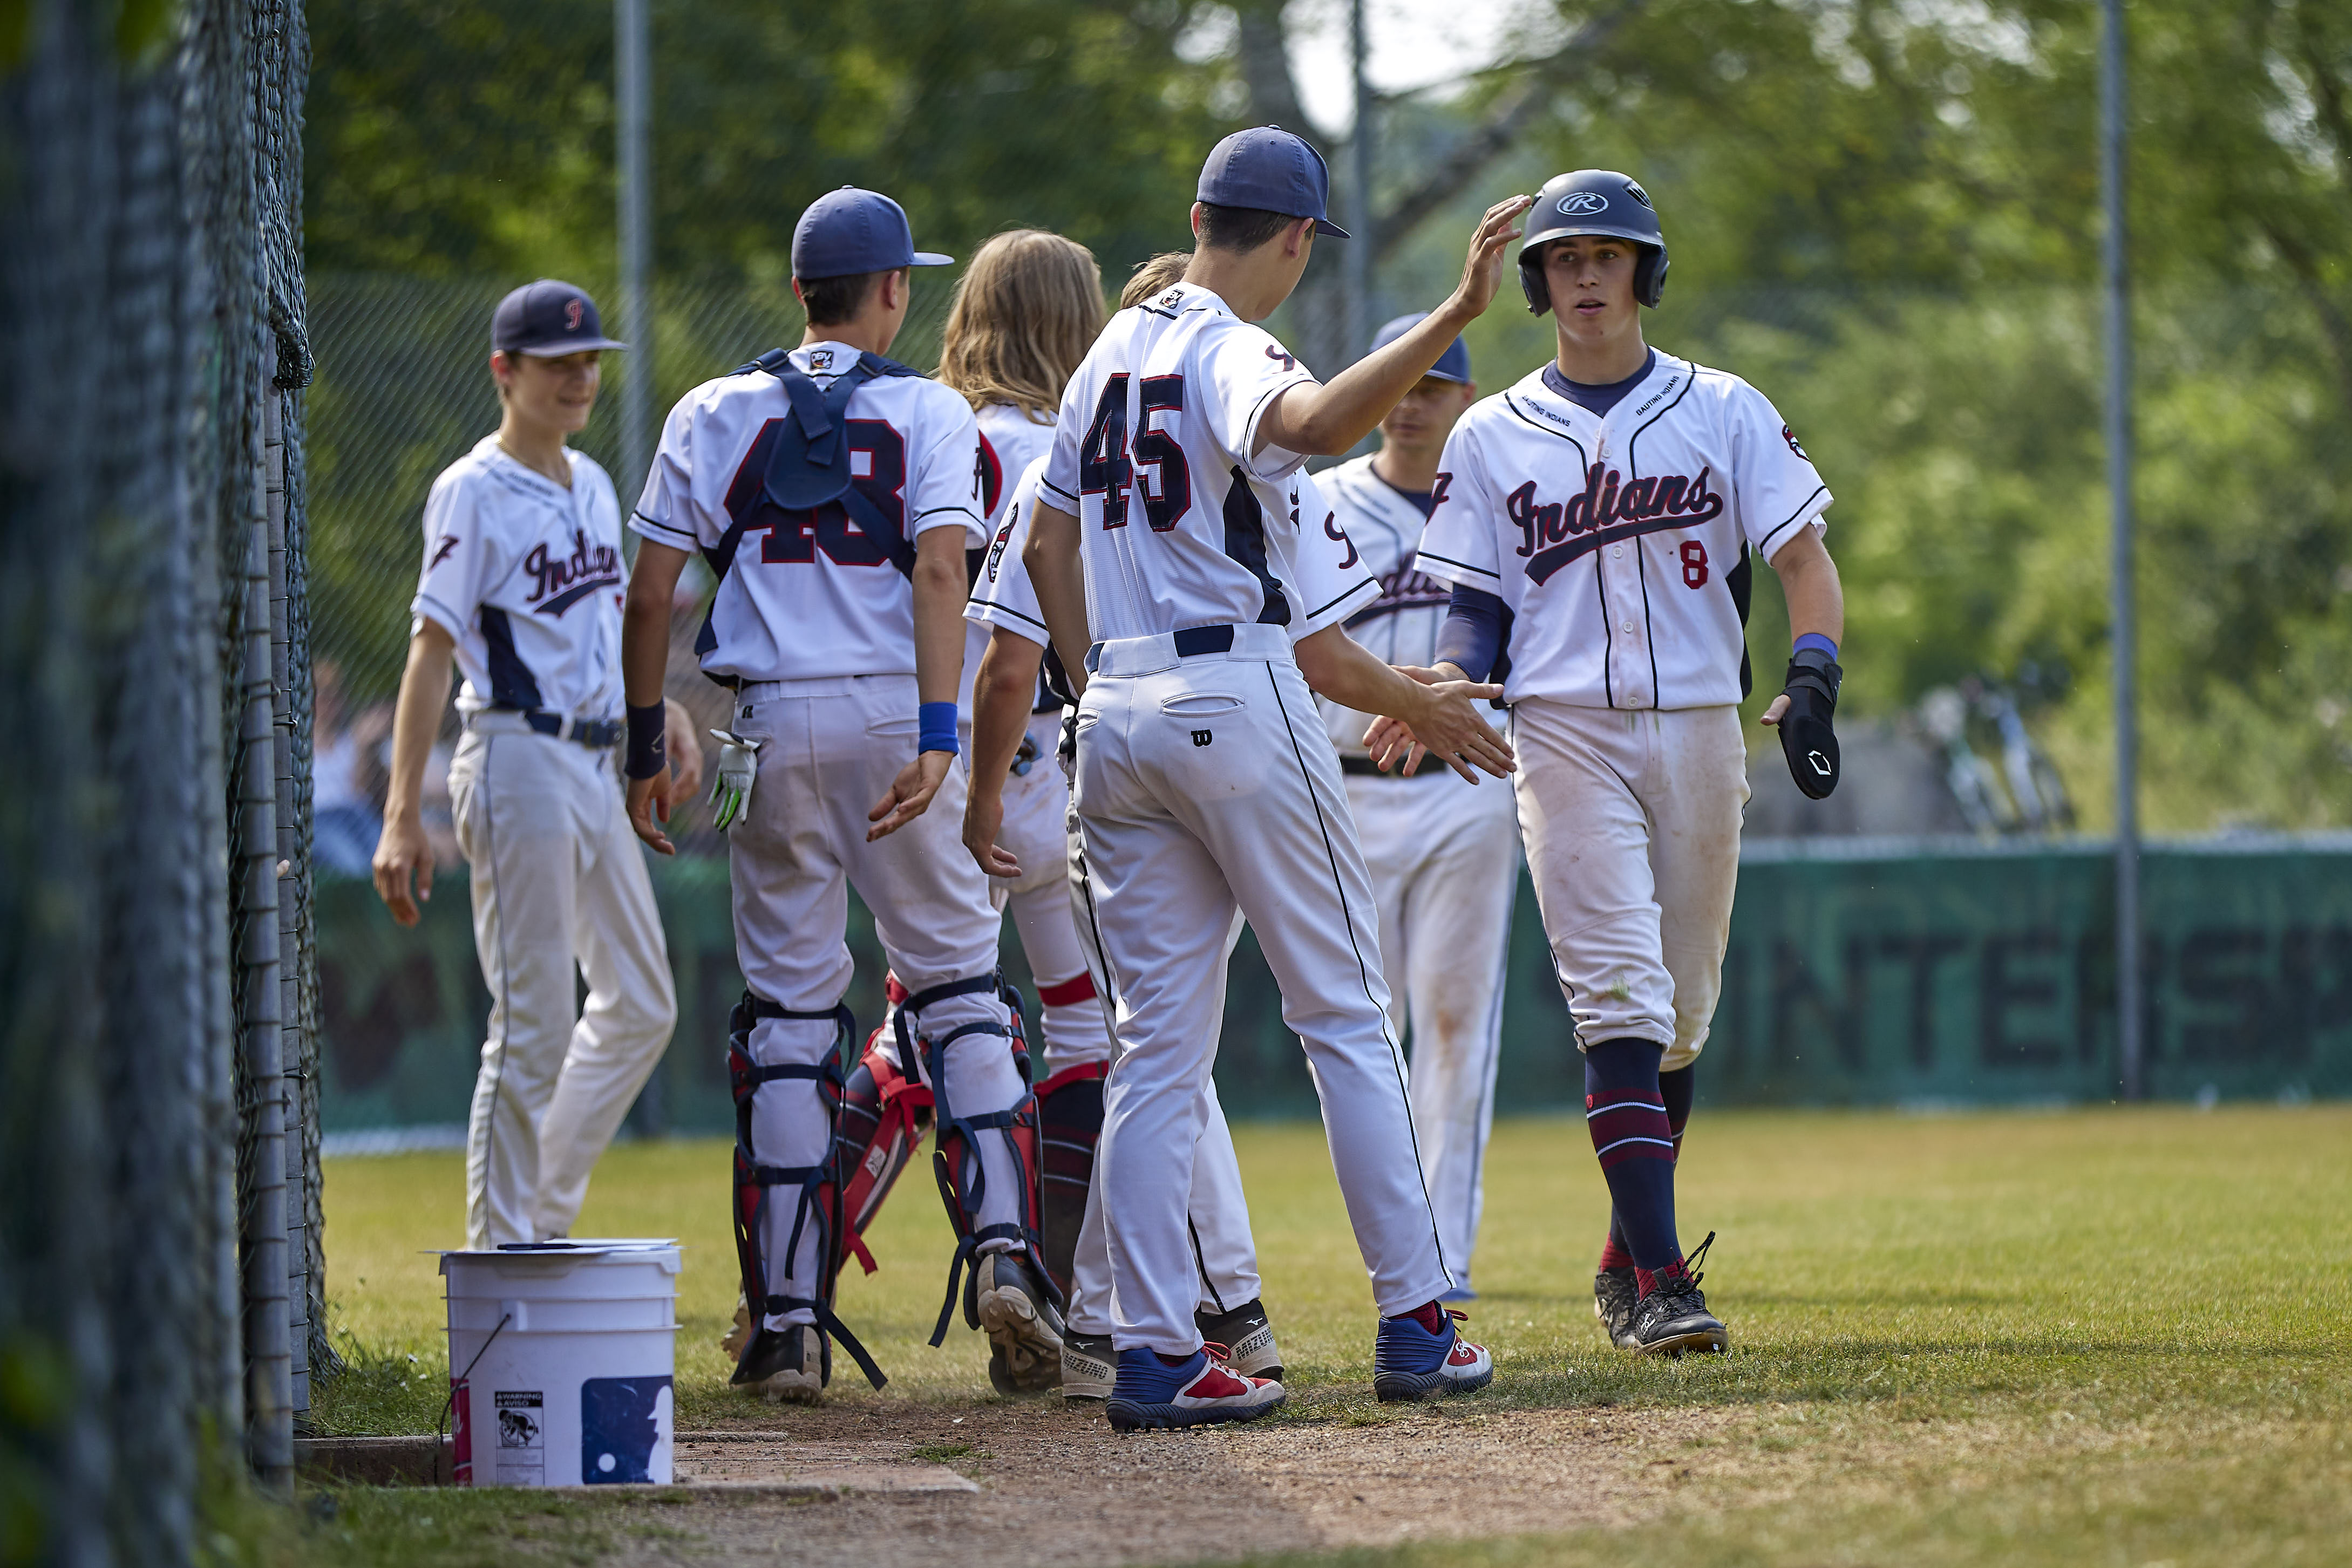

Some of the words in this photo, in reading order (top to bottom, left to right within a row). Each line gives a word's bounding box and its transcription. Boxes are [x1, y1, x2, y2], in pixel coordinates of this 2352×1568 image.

[1660, 375, 1680, 396] INDIANS
[1545, 411, 1571, 427] INDIANS
[1080, 372, 1191, 532] 45
[723, 418, 905, 567] 48
[1507, 461, 1723, 557] Indians
[1680, 540, 1709, 590] 8
[1235, 1326, 1275, 1362] MIZUN
